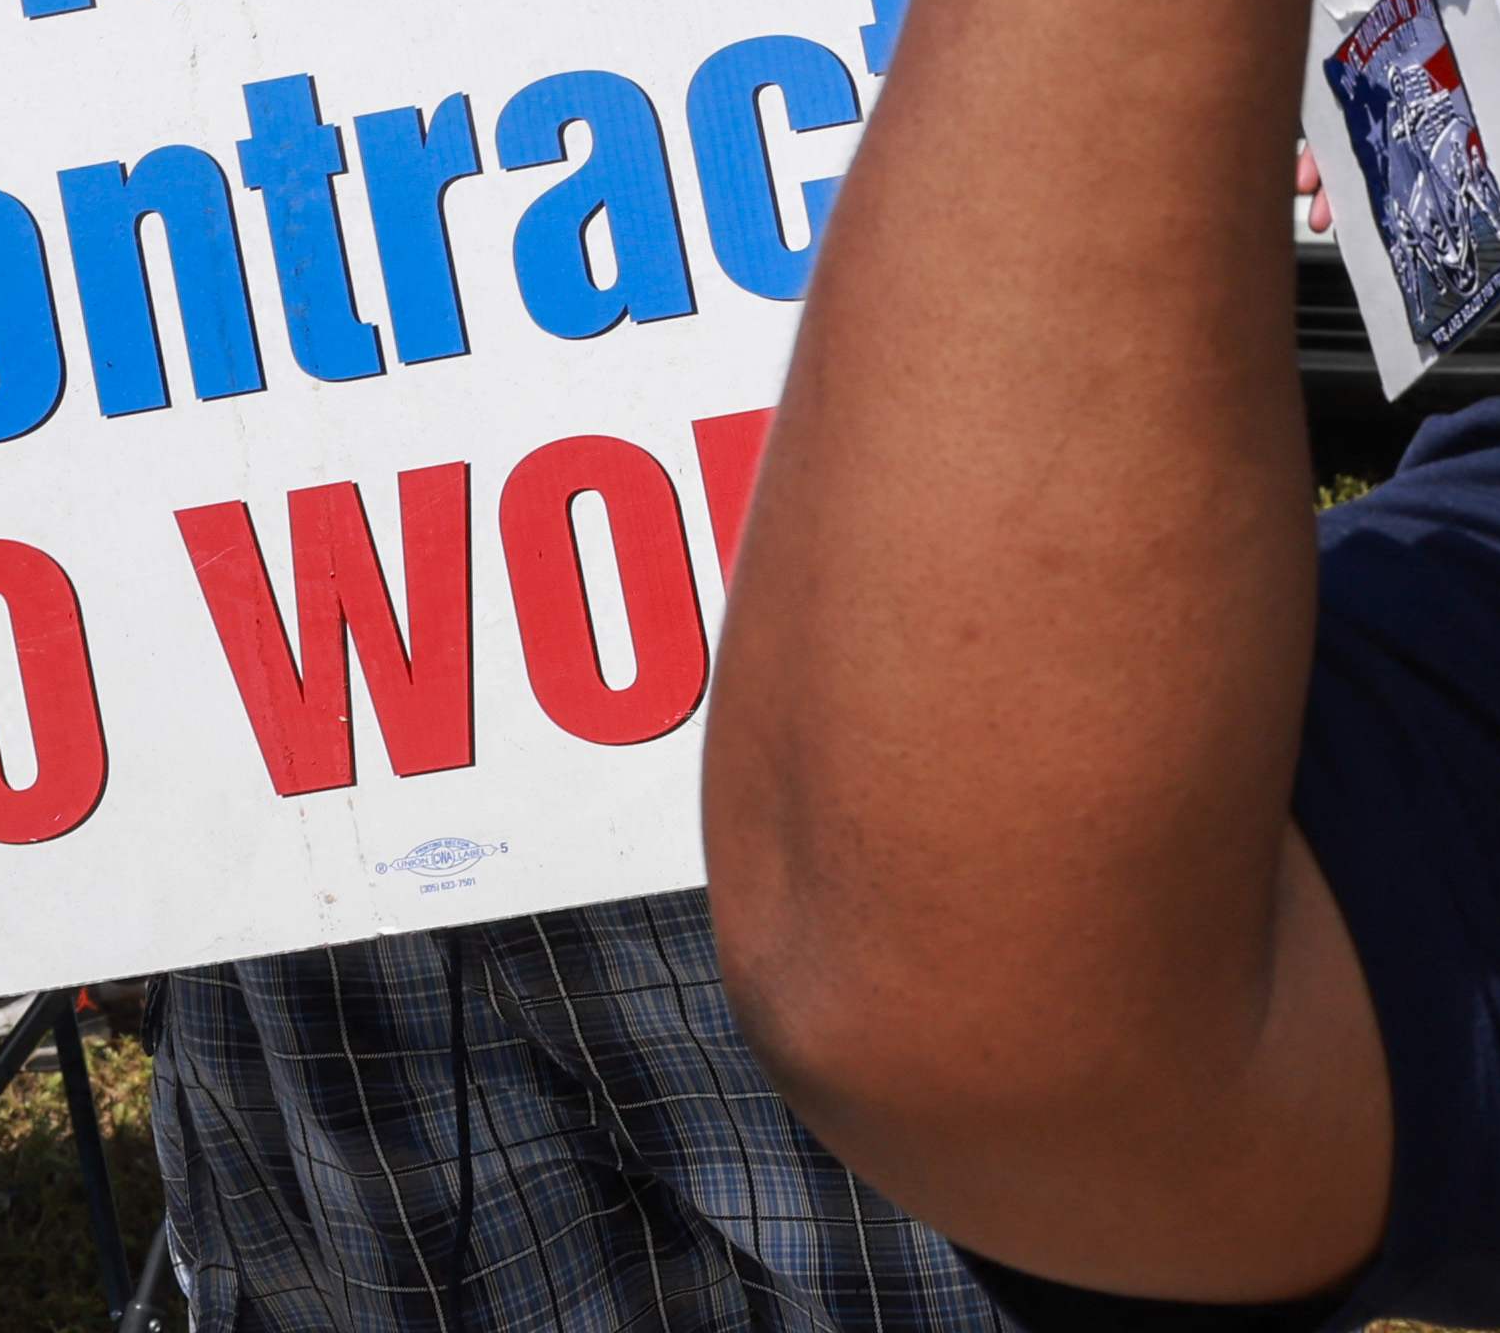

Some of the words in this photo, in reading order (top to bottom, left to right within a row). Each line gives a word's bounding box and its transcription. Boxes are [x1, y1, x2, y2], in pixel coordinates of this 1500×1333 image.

[500, 841, 509, 854] 5
[396, 856, 430, 871] UNION
[457, 847, 487, 862] LABEL
